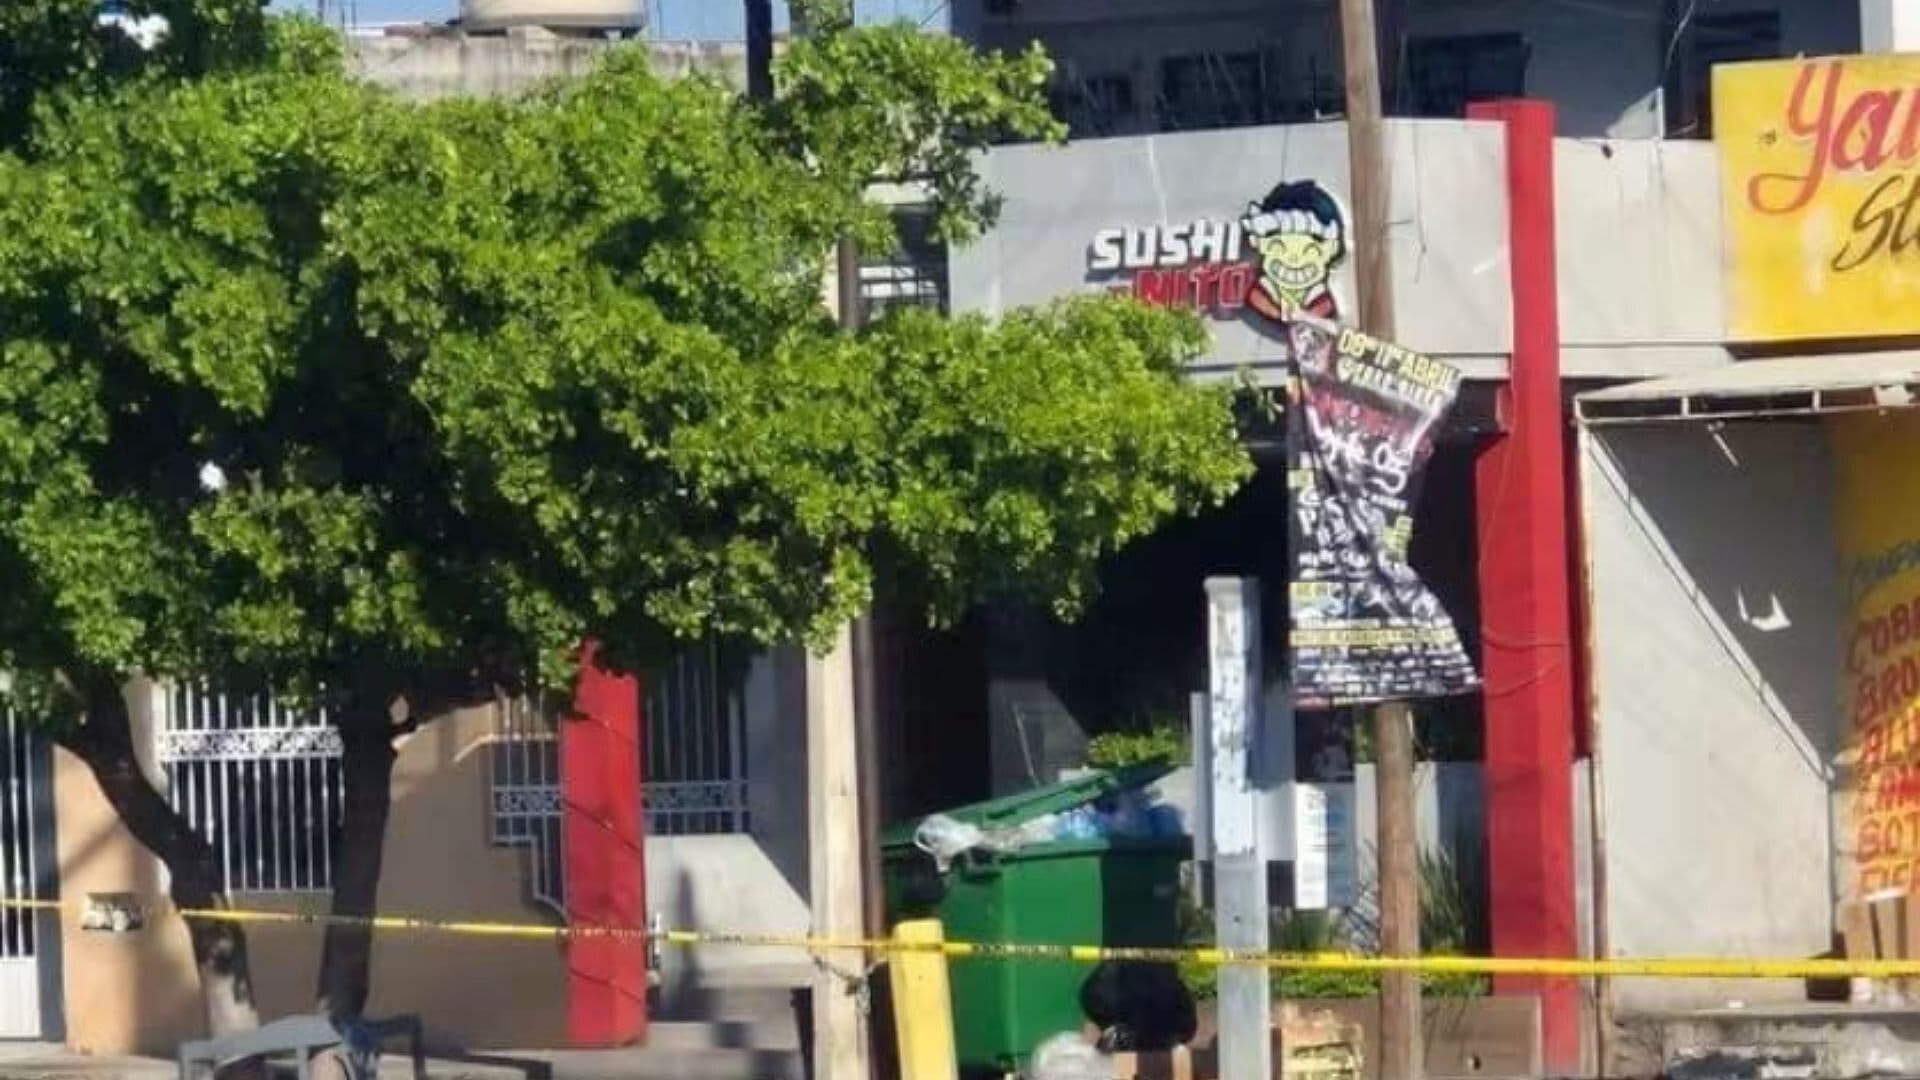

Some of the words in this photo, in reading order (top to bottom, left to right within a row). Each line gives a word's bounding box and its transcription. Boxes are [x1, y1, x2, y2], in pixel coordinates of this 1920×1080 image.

[1091, 219, 1242, 268] SUSHI
[1832, 174, 1920, 272] St
[1110, 263, 1252, 312] NITO
